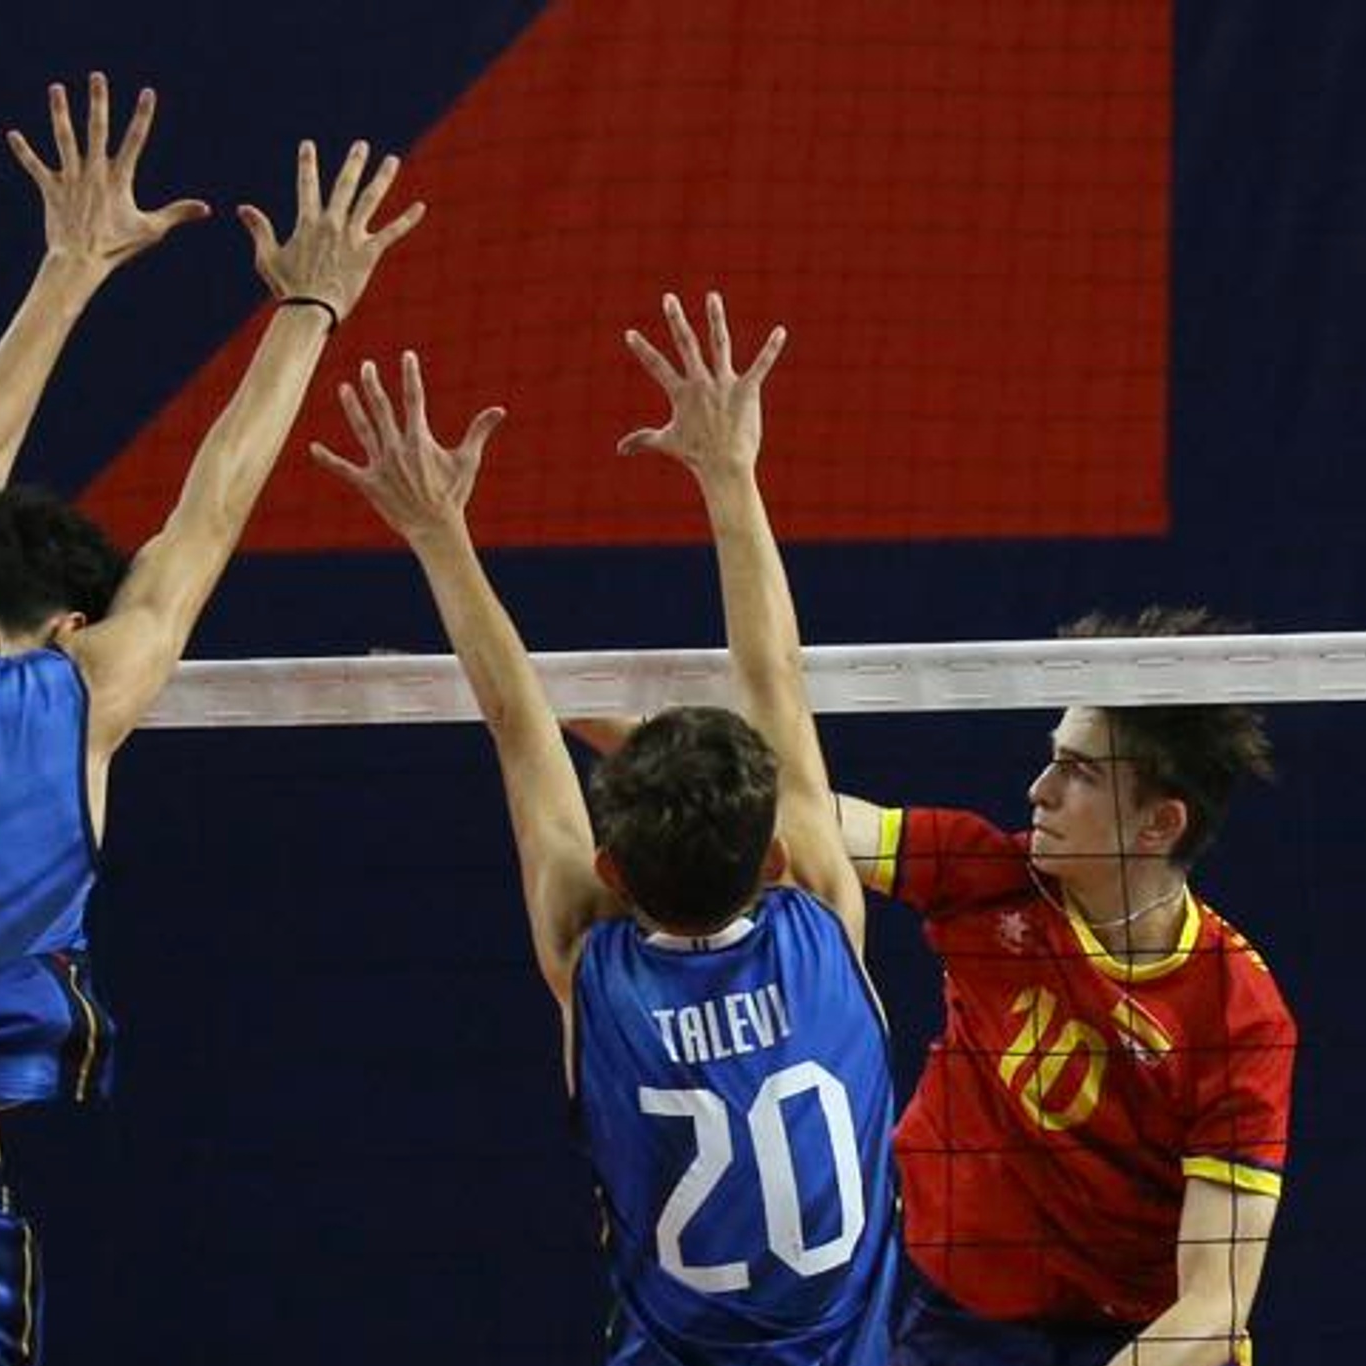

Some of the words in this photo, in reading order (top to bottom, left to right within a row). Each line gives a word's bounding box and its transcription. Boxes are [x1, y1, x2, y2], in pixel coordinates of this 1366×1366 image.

[652, 983, 794, 1064] TALEVI
[999, 986, 1108, 1131] 10
[639, 1060, 866, 1293] 20
